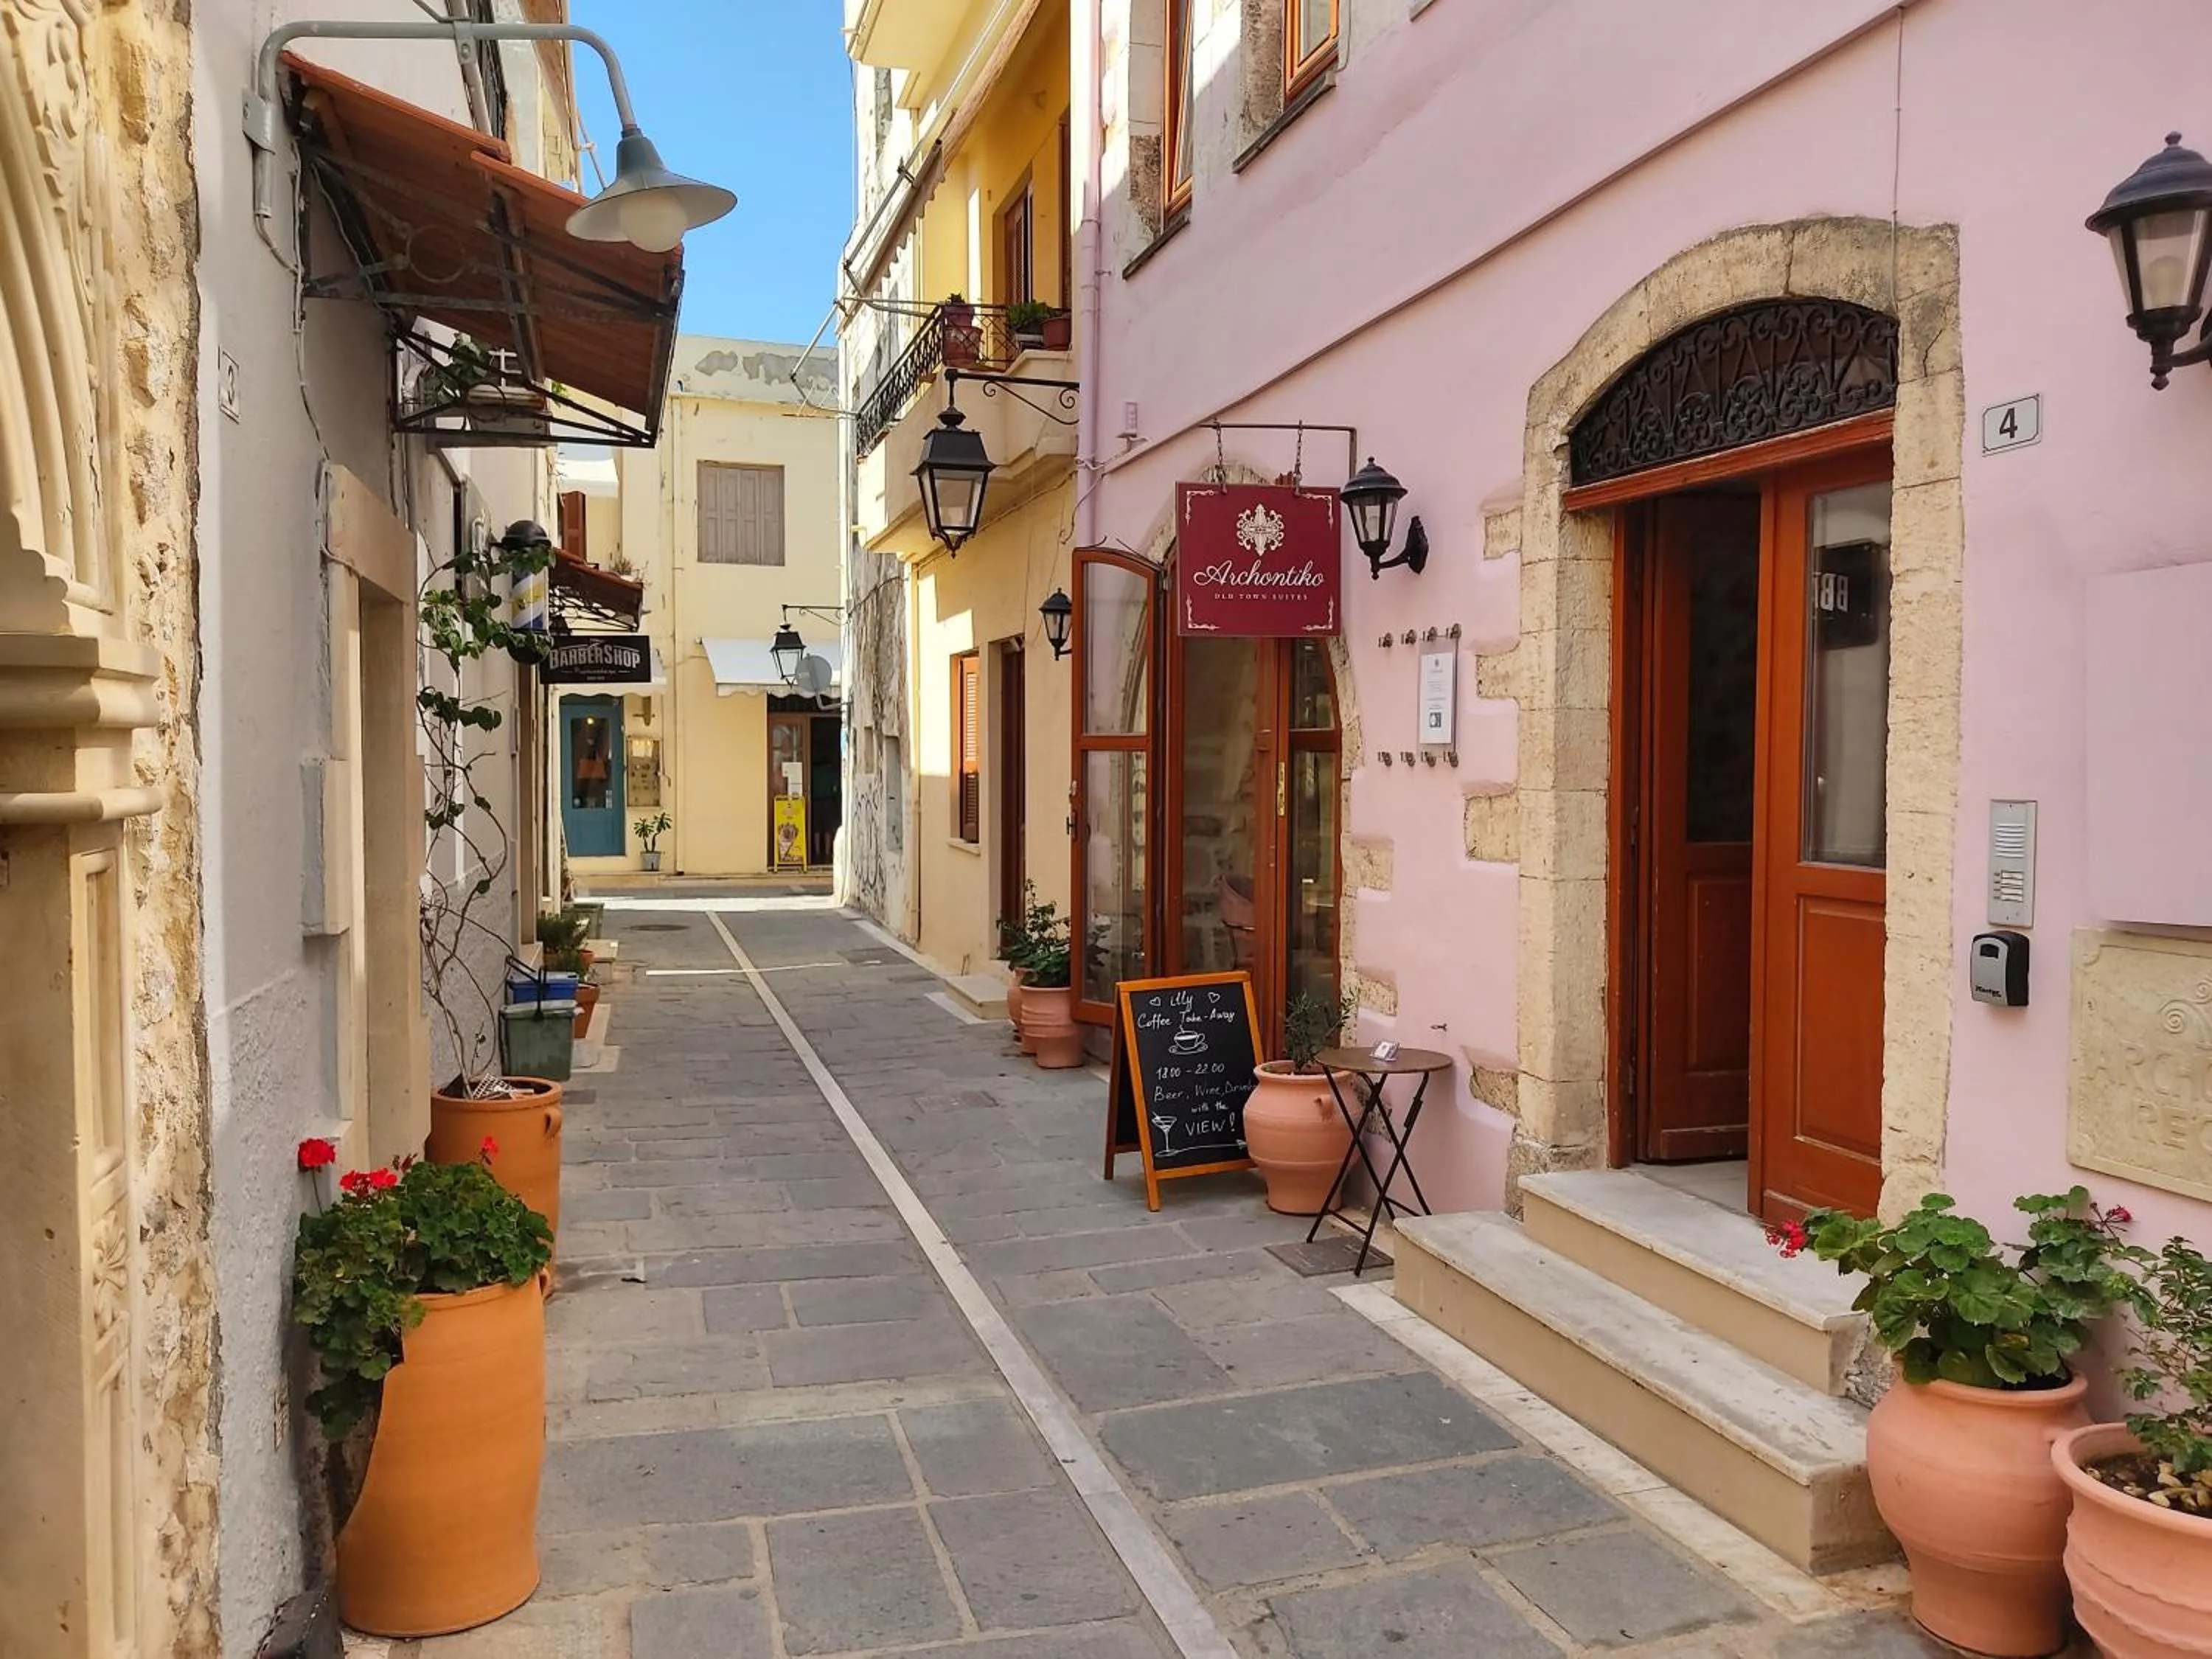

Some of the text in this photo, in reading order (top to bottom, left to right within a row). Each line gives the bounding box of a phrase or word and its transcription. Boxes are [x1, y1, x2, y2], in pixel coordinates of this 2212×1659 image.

[1999, 407, 2018, 439] 4
[1193, 560, 1325, 588] Archontiko
[1214, 592, 1234, 600] OLD
[1137, 1012, 1173, 1030] Coffee
[1191, 1100, 1230, 1115] with the
